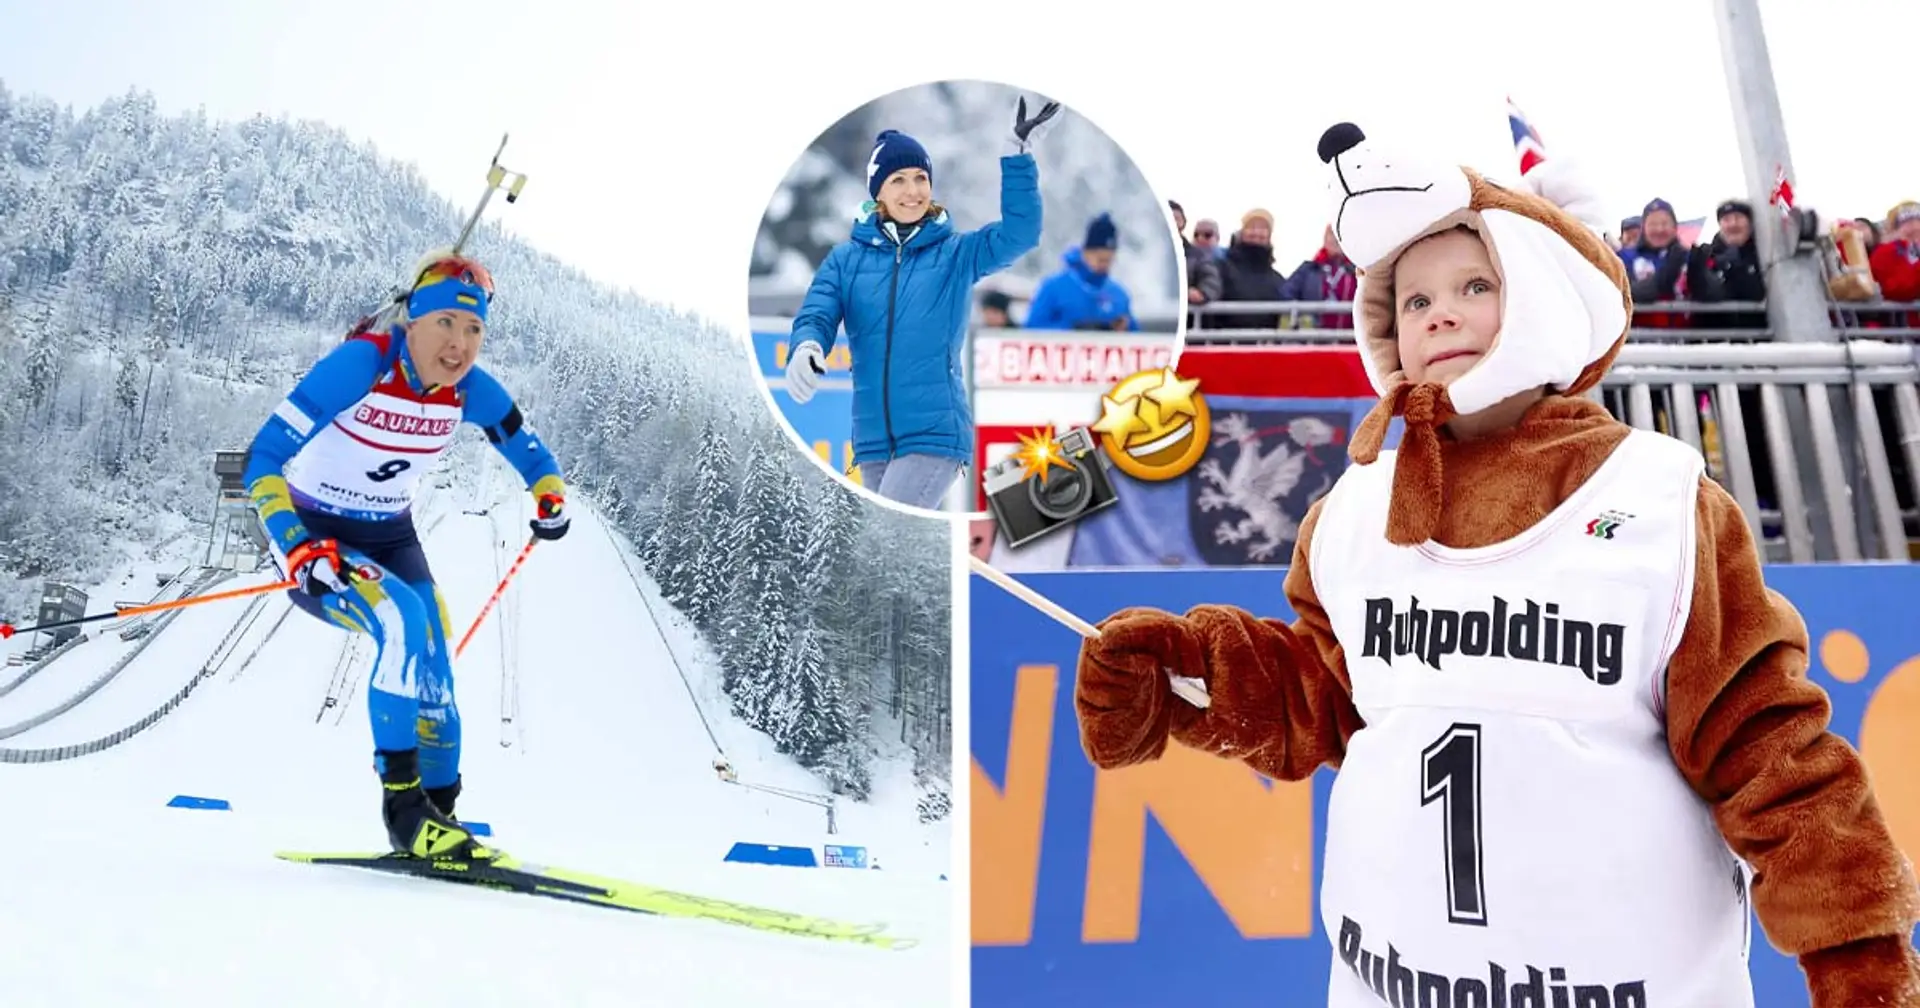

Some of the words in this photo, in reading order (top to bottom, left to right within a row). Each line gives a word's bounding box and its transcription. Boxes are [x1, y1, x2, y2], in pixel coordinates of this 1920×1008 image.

[354, 403, 457, 436] BAUHAUS
[365, 459, 411, 482] 9
[1361, 595, 1627, 686] Ruhpolding
[1421, 722, 1488, 927] 1
